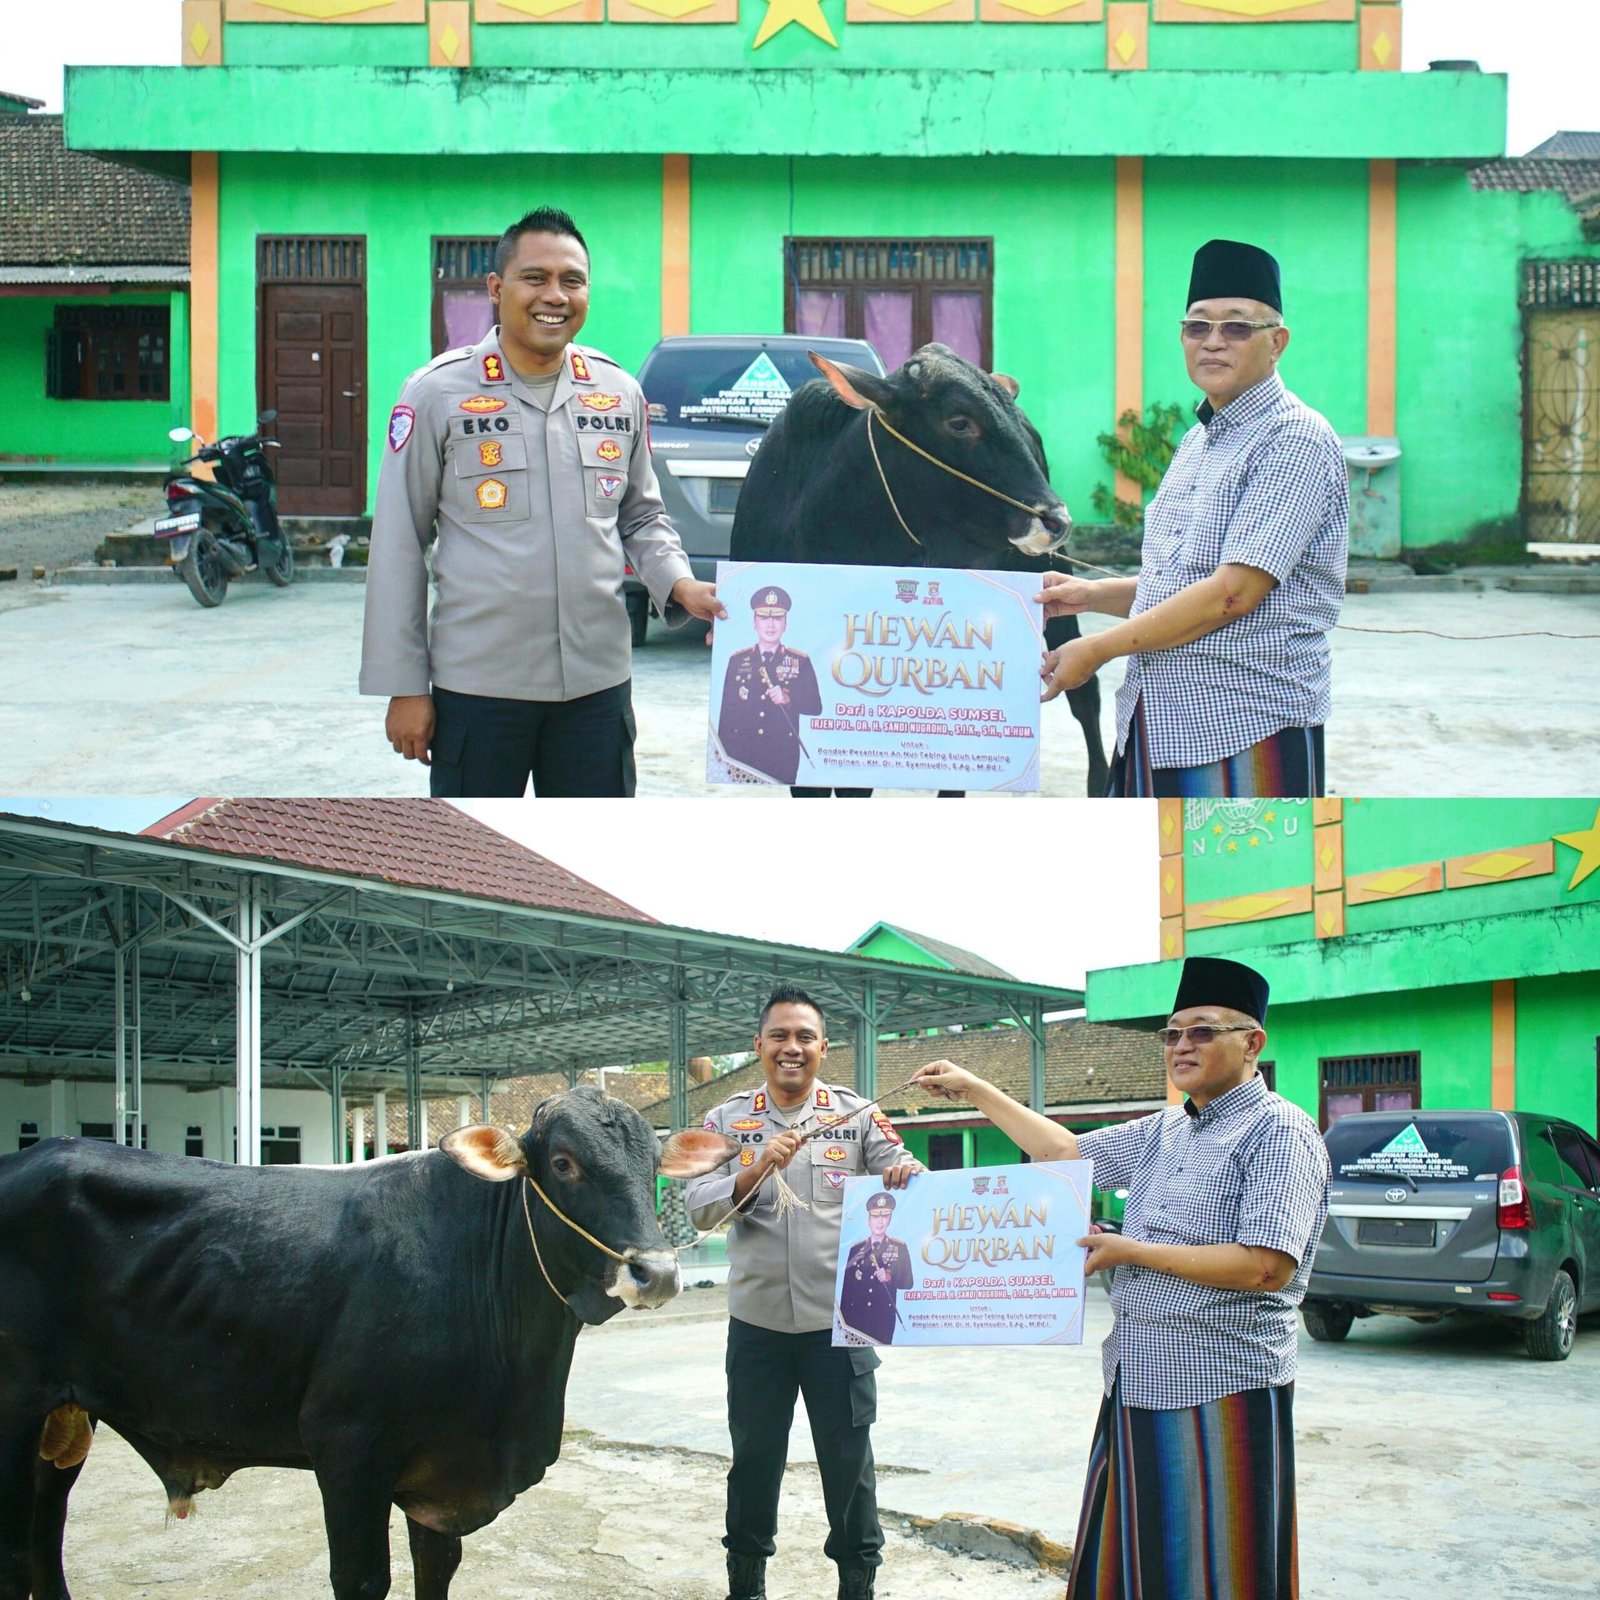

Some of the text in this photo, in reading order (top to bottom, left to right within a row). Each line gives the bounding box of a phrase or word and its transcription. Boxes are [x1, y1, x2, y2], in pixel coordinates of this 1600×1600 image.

[766, 391, 793, 399] CABA
[463, 417, 510, 435] EKO
[578, 416, 631, 432] POLRI
[844, 610, 993, 651] HEWAN
[832, 652, 1005, 697] QURBAN
[836, 703, 866, 717] Dari
[877, 705, 946, 720] KAPOLDA
[949, 707, 1007, 722] SUMSEL
[811, 718, 834, 730] IRJEN
[835, 719, 855, 731] POL.
[883, 721, 908, 733] SANDI
[1192, 817, 1298, 856] N U
[733, 1133, 763, 1143] KO
[933, 1198, 1047, 1236] HEWAN
[922, 1234, 1056, 1272] QURBAN
[923, 1278, 945, 1288] Dari
[954, 1276, 1006, 1287] KAPOLDA
[1008, 1275, 1055, 1286] SUMSEL
